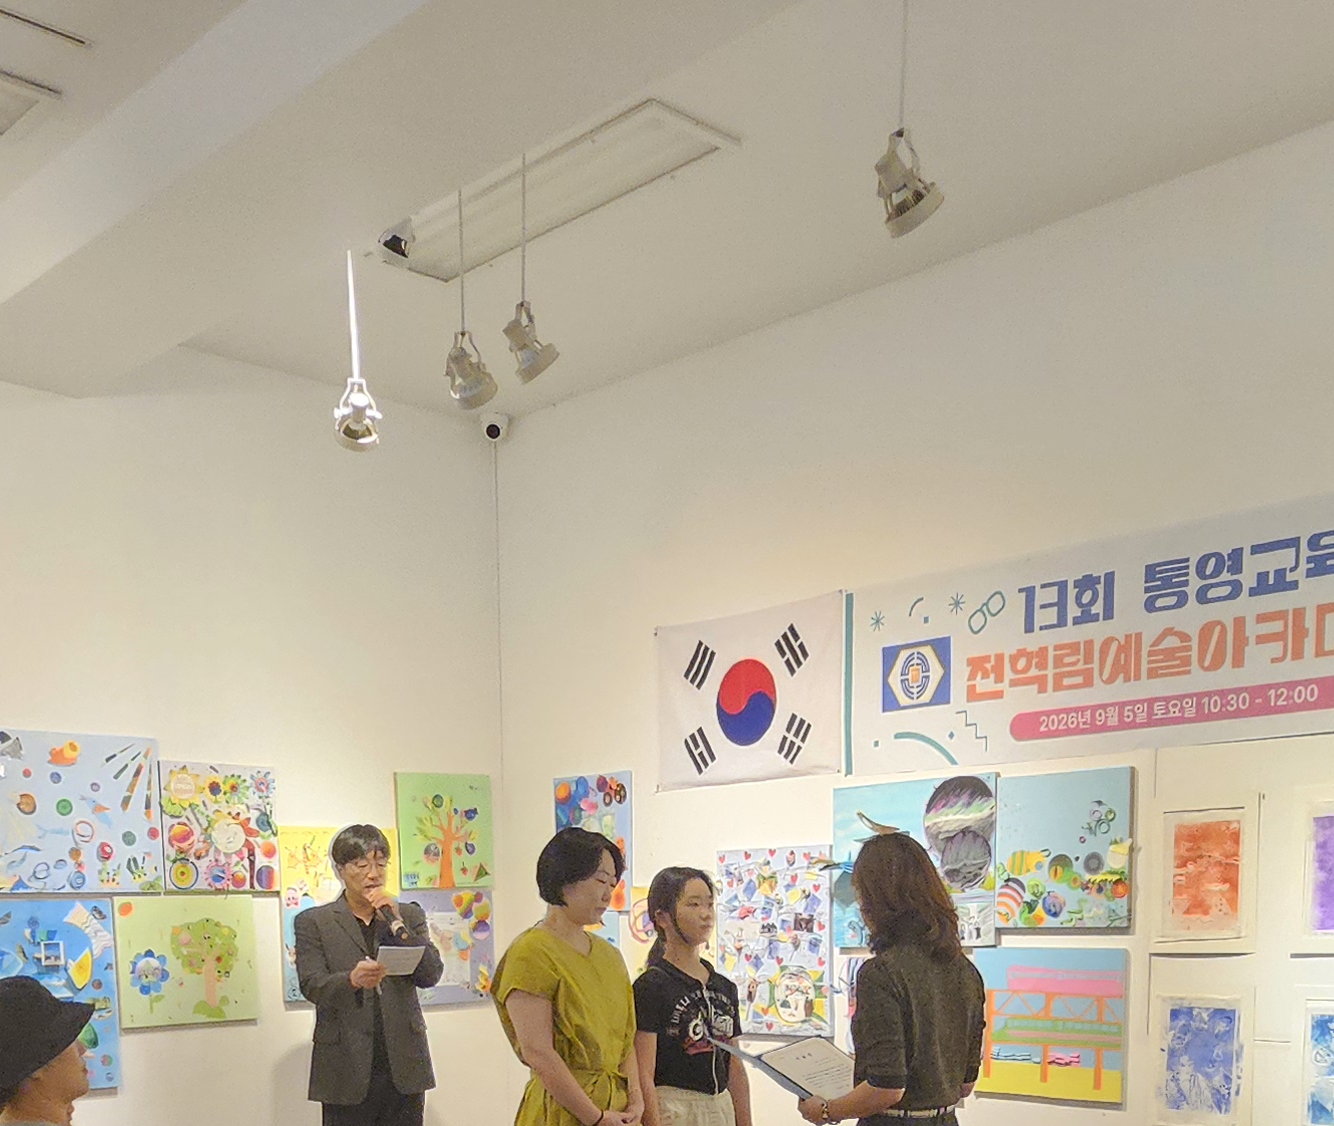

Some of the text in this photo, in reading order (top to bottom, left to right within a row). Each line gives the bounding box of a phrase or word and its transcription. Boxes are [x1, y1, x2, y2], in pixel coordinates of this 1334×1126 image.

[1018, 570, 1115, 634] 13회
[1039, 709, 1092, 732] 2026년
[1095, 706, 1119, 727] 9월
[1123, 702, 1148, 723] 5일
[1152, 696, 1197, 720] 토요일
[1202, 692, 1250, 715] 10:30
[1267, 683, 1319, 708] 12:00
